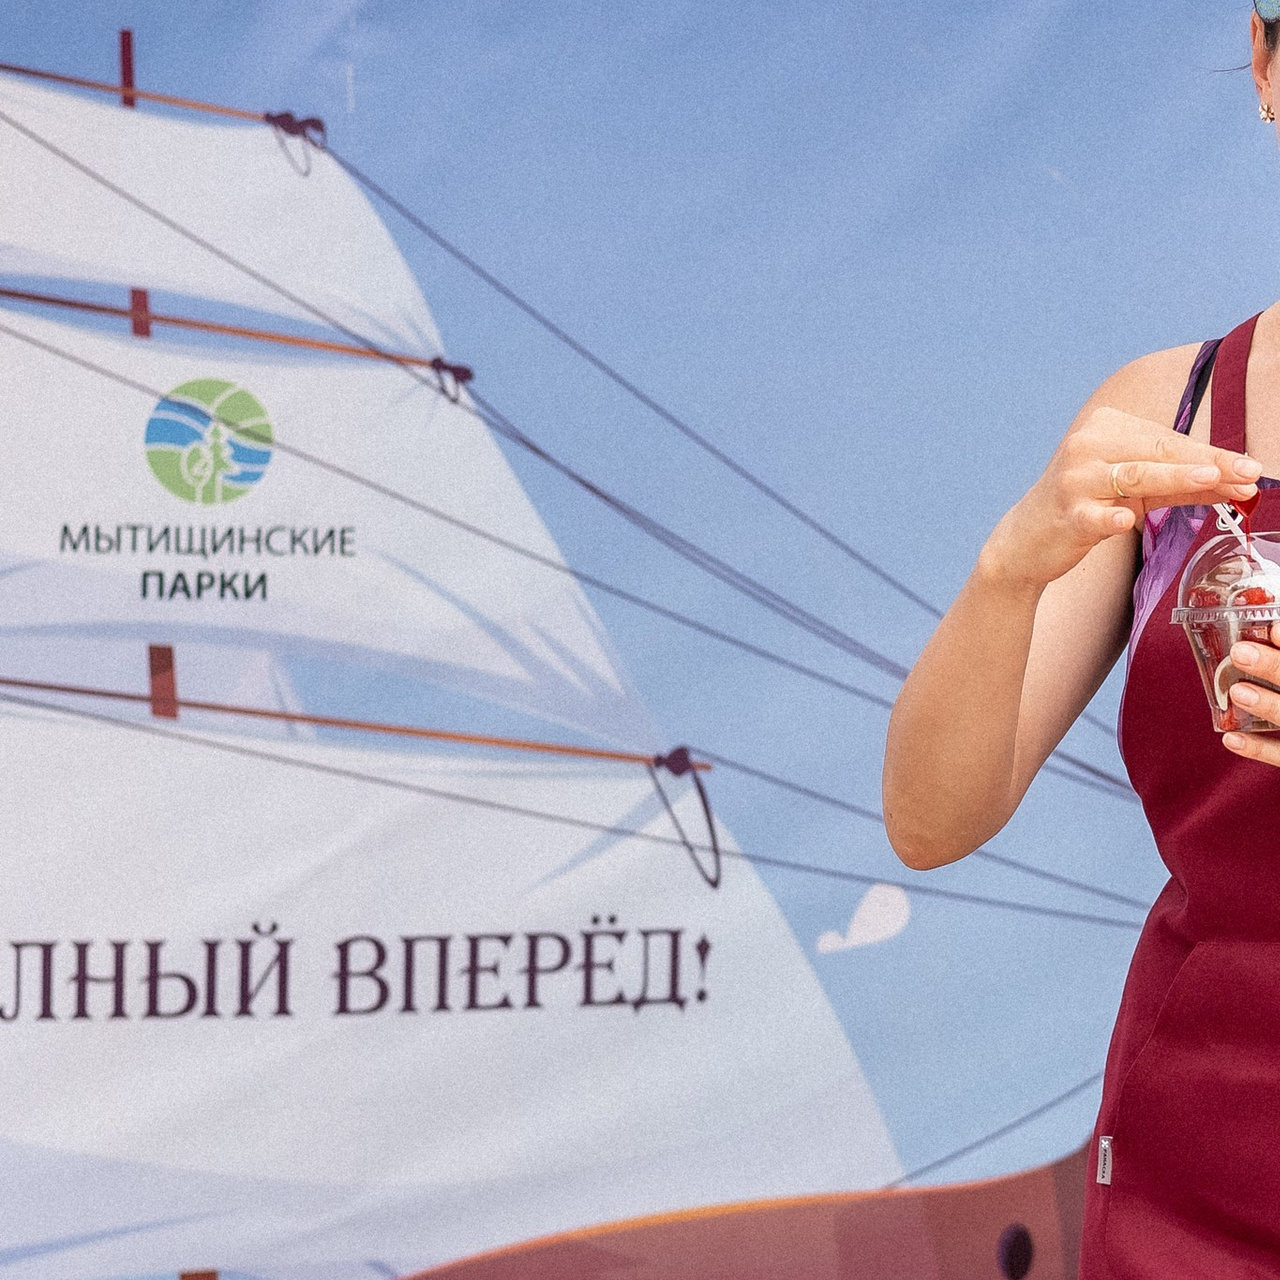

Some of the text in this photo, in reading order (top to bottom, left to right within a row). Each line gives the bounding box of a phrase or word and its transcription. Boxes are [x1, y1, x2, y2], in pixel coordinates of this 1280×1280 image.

[59, 523, 356, 559] МЫТИЩИНСКИЕ
[140, 571, 268, 600] ПАРКИ
[332, 914, 712, 1016] ВПЕРЁД!
